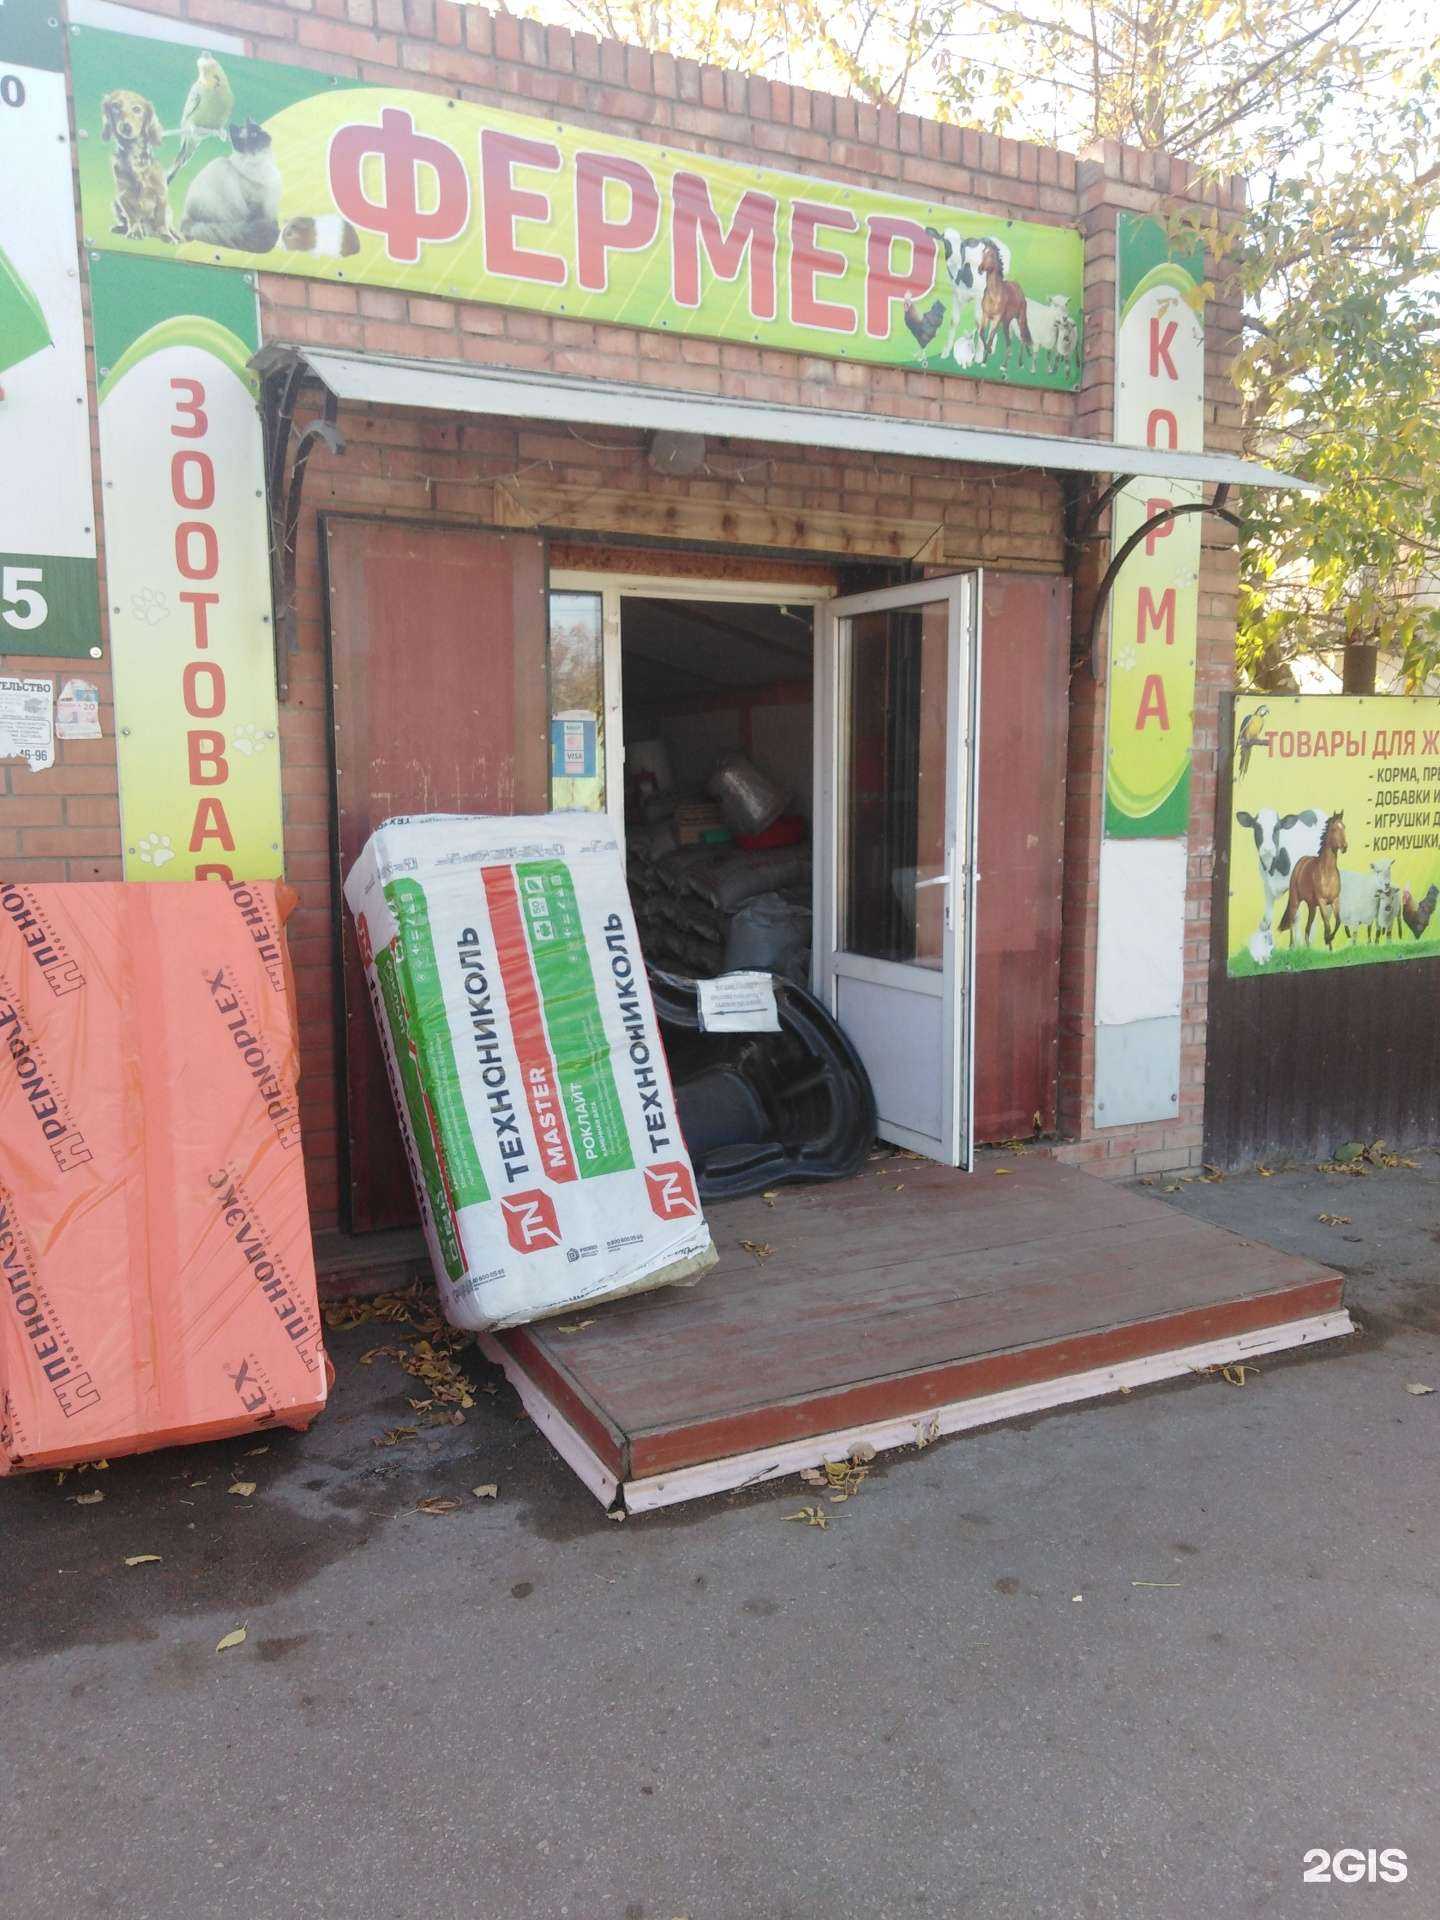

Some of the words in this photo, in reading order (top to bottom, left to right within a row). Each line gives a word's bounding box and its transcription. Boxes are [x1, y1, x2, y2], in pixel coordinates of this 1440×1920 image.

[328, 106, 940, 340] ФЕРМЕР
[2, 566, 49, 630] 5
[1265, 729, 1366, 758] ТОВАРЫ
[1372, 730, 1416, 760] ДЛЯ
[1377, 766, 1420, 784] КОРМА,
[1374, 812, 1430, 829] ИГРУШКИ
[1375, 790, 1431, 808] ДОБАВКИ
[0, 976, 70, 1140] PENOPLE
[206, 967, 289, 1121] PENOPLEX
[459, 926, 529, 1184] ТЕХНОНИКОЛЬ
[603, 912, 672, 1154] ТЕХНОНИКОЛЬ
[527, 1066, 567, 1168] MASTER
[568, 1081, 598, 1160] РОКЛАЙТ
[207, 1167, 309, 1343] ПЕНОПЛЭКС
